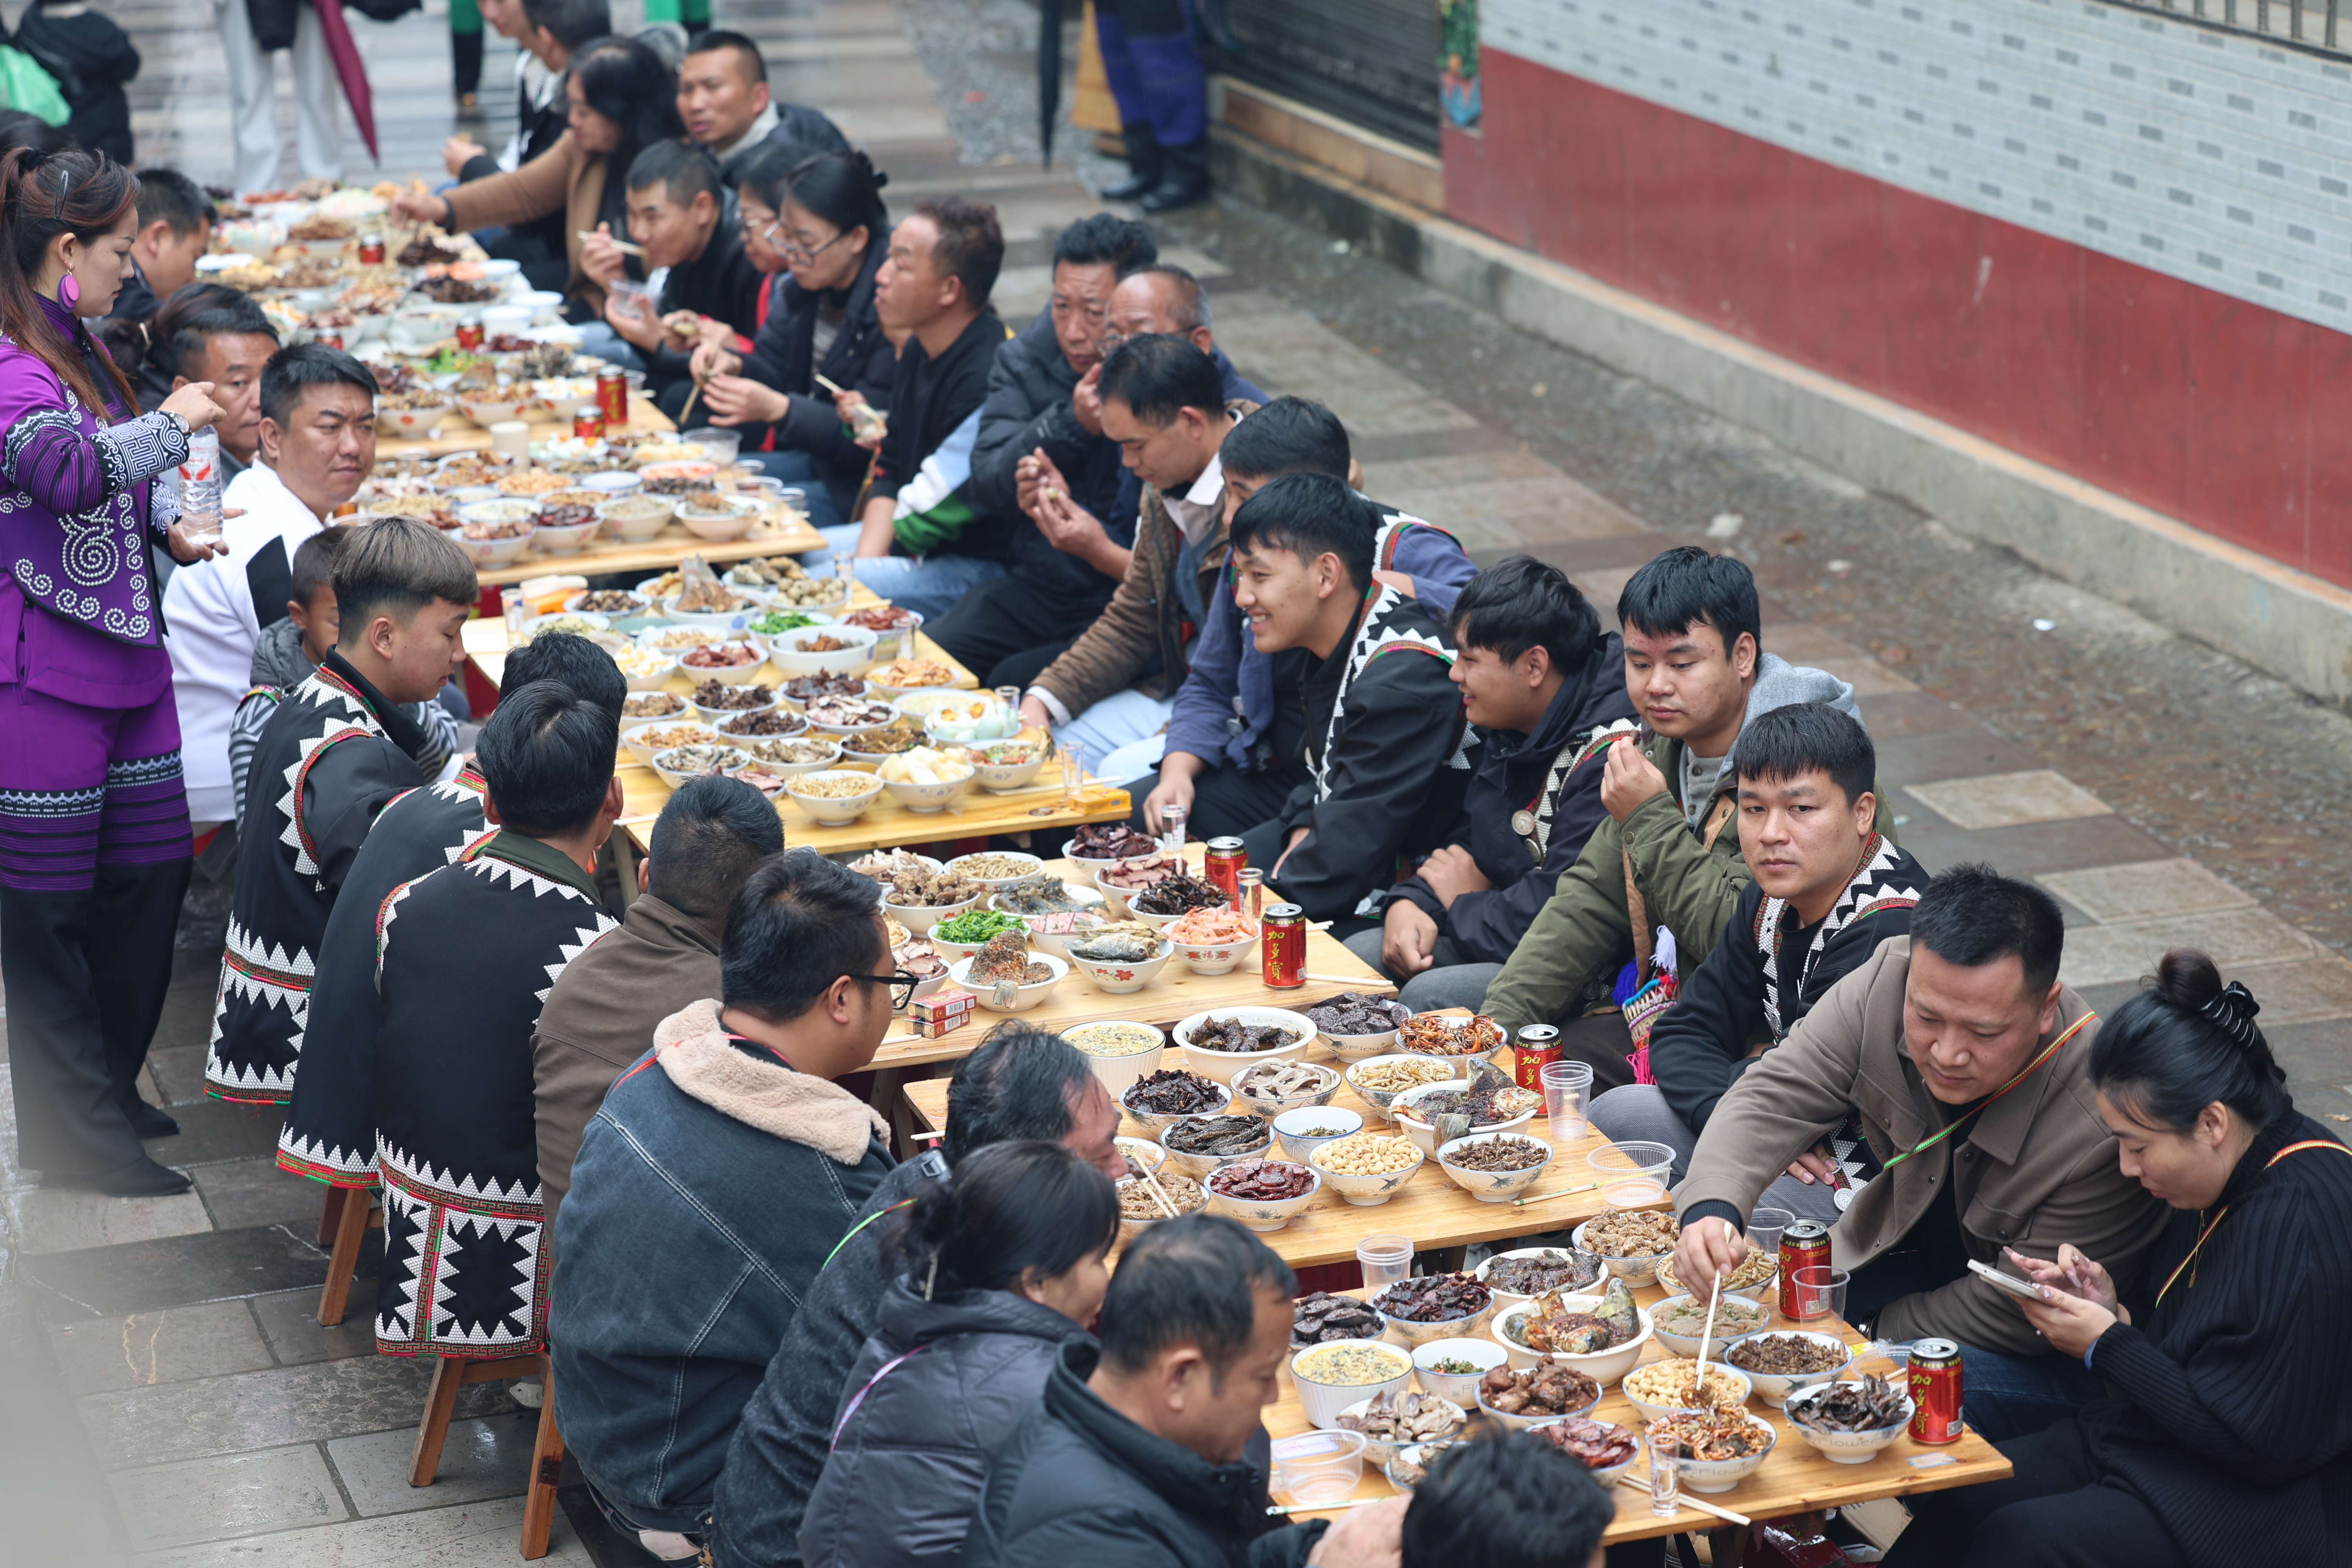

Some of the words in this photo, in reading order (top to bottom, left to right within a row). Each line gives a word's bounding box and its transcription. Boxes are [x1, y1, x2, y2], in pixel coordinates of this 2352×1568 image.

[1349, 1043, 1396, 1051] Flower
[1520, 1055, 1541, 1092] 加多
[1818, 1437, 1877, 1447] Flower
